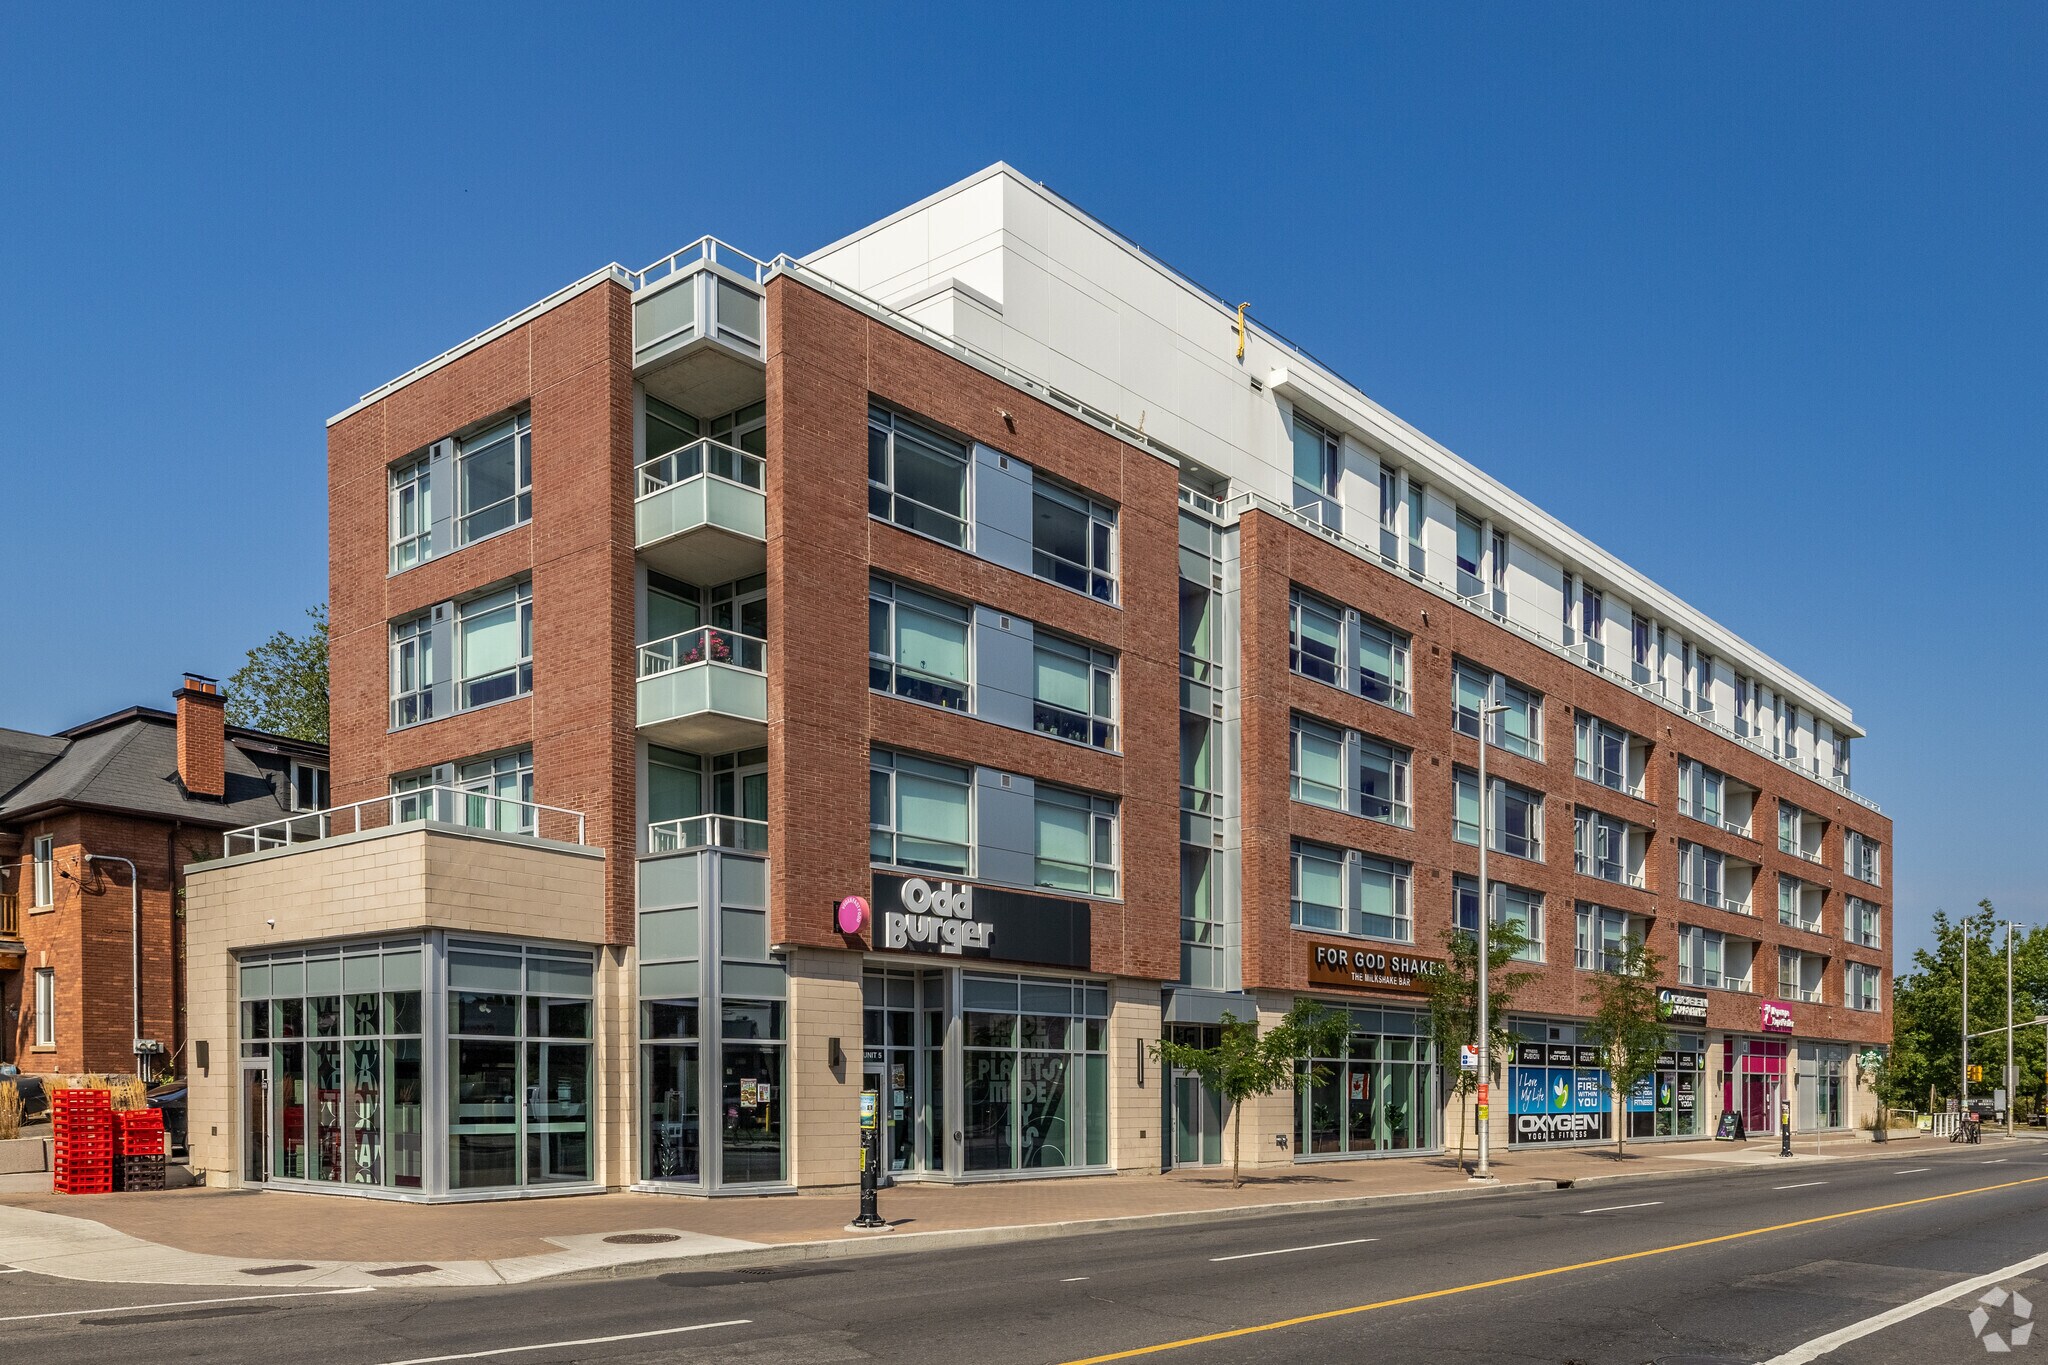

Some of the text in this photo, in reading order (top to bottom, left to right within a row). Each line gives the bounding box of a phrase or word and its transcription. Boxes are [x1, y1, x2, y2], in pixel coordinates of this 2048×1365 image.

[901, 878, 972, 919] Odd
[885, 911, 994, 955] Burger
[1317, 947, 1348, 965] FOR
[1355, 951, 1385, 969] GOD
[1351, 972, 1363, 981] THE
[1398, 977, 1411, 986] BAR
[990, 1015, 1047, 1036] MDE
[1519, 1073, 1538, 1087] I Love
[1577, 1082, 1598, 1091] FIRE
[990, 1081, 1047, 1103] MDE
[1521, 1087, 1545, 1112] My Life
[1578, 1098, 1597, 1107] YOU
[1519, 1114, 1599, 1132] OXYGEN
[1528, 1132, 1546, 1140] YOGA
[1559, 1130, 1587, 1138] FITNESS
